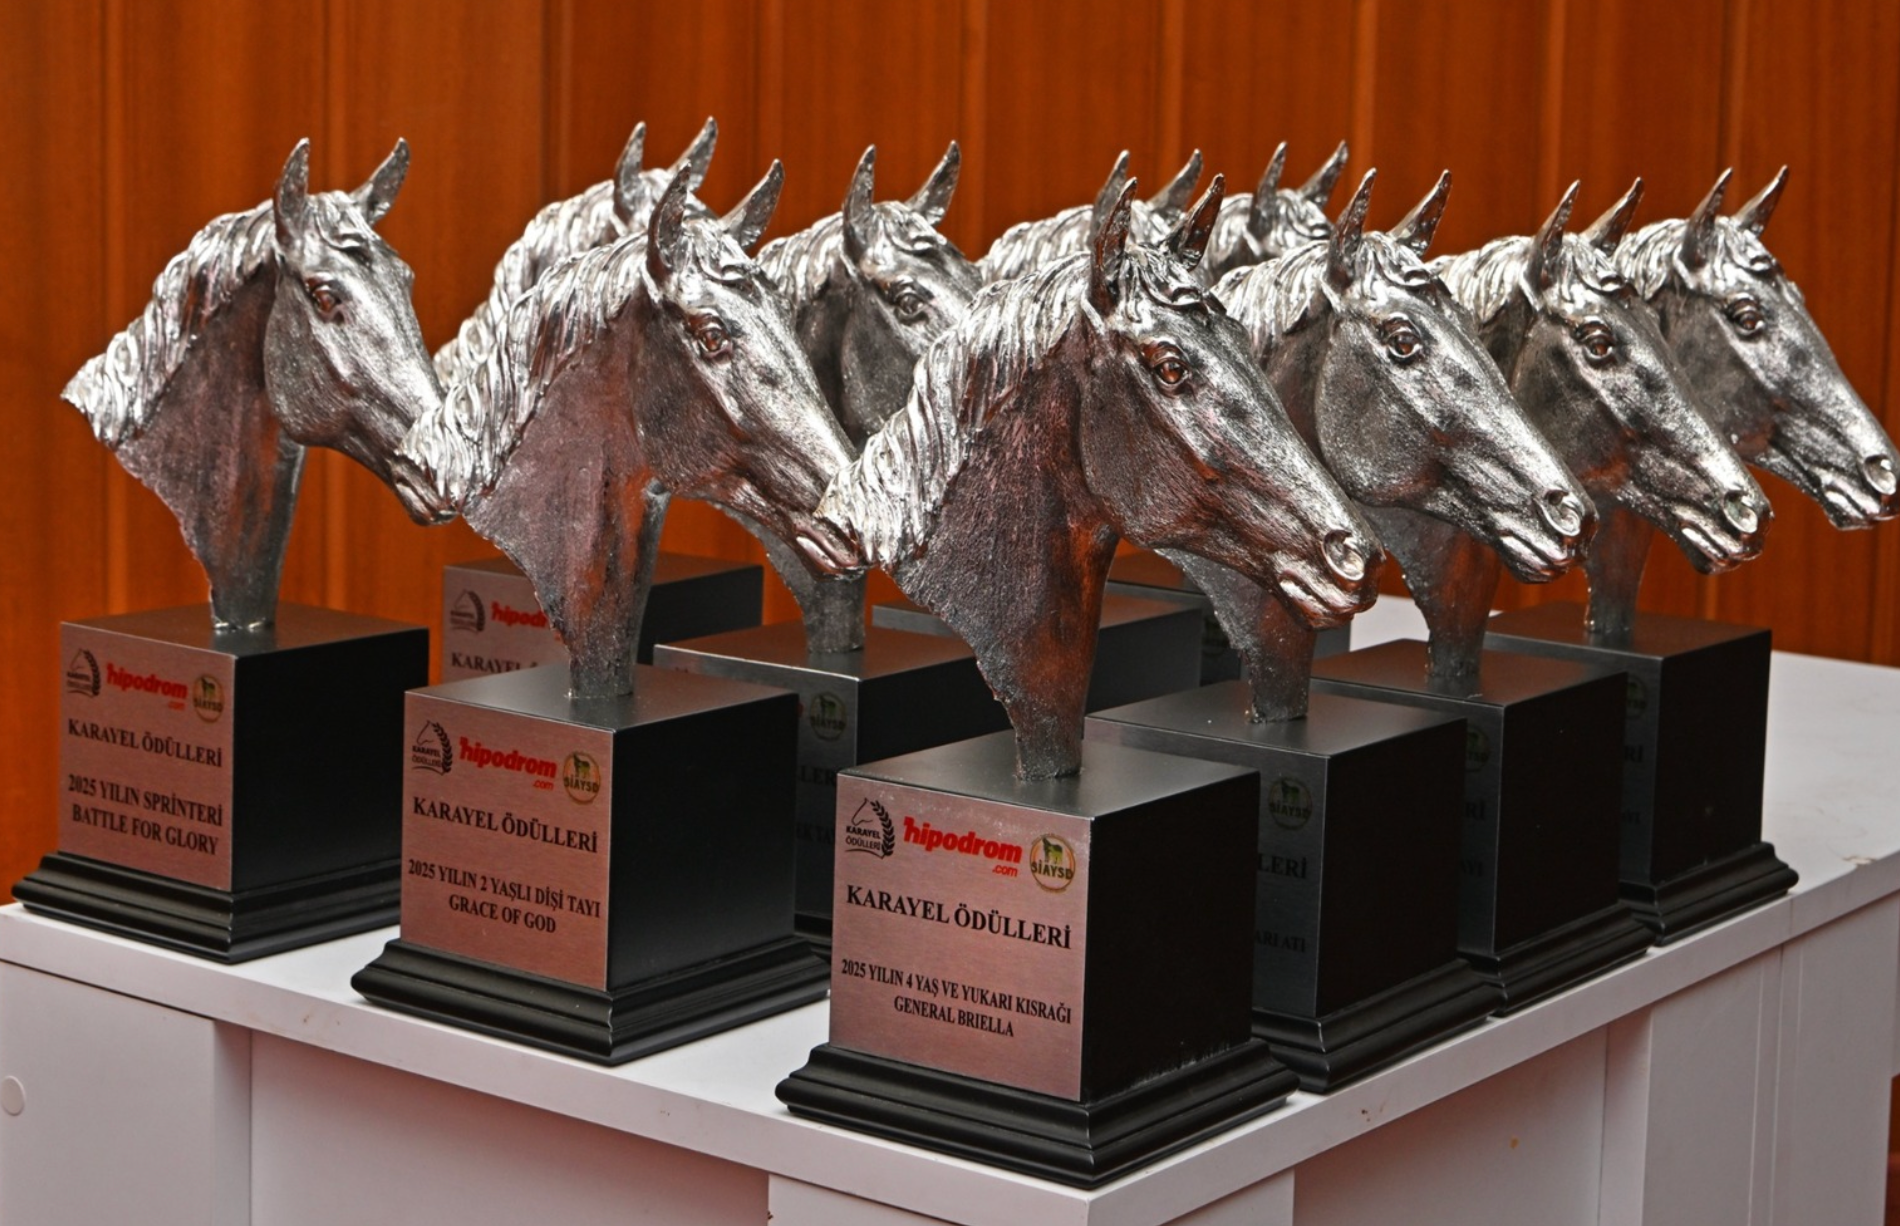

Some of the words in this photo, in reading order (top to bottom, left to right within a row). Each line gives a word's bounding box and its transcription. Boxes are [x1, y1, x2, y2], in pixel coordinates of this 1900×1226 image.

[106, 663, 188, 699] hipodrom
[68, 719, 139, 749] KARAYEL
[142, 732, 222, 767] ÖDÜLLERİ
[459, 737, 557, 779] hipodrom
[68, 774, 97, 796] 2025
[100, 780, 140, 804] YILIN
[144, 792, 222, 826] SPRİNTERİ
[533, 779, 554, 791] .com
[72, 804, 128, 834] BATTLE
[132, 817, 161, 842] FOR
[166, 827, 219, 855] GLORY
[413, 797, 499, 831] KARAYEL
[501, 813, 598, 853] ÖDÜLLERİ
[845, 835, 881, 851] ÖDÜLLERİ
[846, 825, 881, 840] KARAYEL
[903, 816, 1022, 864] hipodrom
[408, 858, 436, 878] 2025
[438, 866, 477, 889] YILIN
[480, 876, 487, 891] 2
[490, 878, 532, 902] YAŞLI
[535, 886, 564, 911] DİŞİ
[567, 895, 600, 918] TAYI
[992, 863, 1018, 877] .com
[1030, 858, 1075, 880] SİAYSD
[448, 893, 498, 920] GRACE
[501, 907, 521, 925] OF
[524, 911, 556, 933] GOD
[846, 885, 949, 924] KARAYEL
[954, 903, 1071, 949] ÖDÜLLERİ
[841, 958, 866, 978] 2025
[868, 965, 903, 987] YILIN
[905, 973, 913, 989] 4
[915, 974, 938, 998] YAŞ
[941, 980, 959, 999] VE
[961, 984, 1012, 1011] YUKARI
[1015, 997, 1072, 1024] KISRAĞI
[893, 995, 955, 1024] GENERAL
[957, 1010, 1014, 1037] BRIELLA
